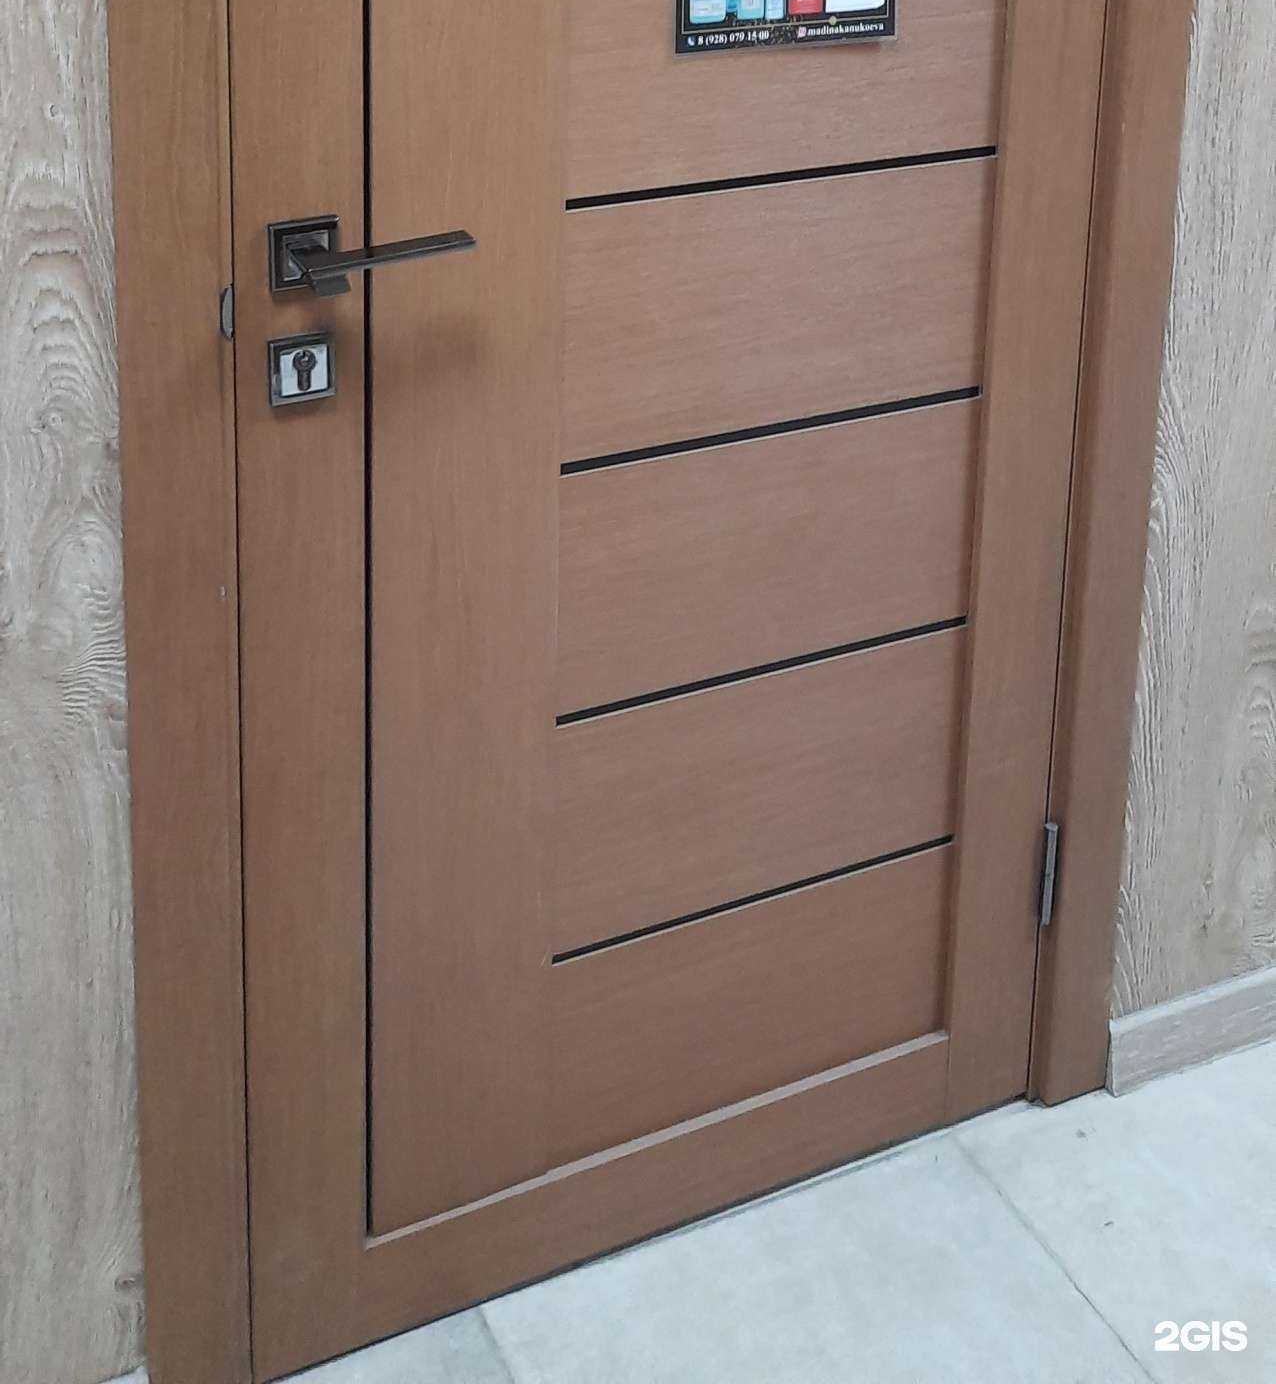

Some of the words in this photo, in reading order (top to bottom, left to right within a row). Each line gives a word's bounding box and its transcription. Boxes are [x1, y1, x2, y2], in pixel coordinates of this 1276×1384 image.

[808, 22, 885, 36] madinakanukoeva
[697, 35, 703, 45] 8
[705, 33, 728, 45] (928)
[729, 32, 745, 42] 079
[758, 30, 770, 40] 00
